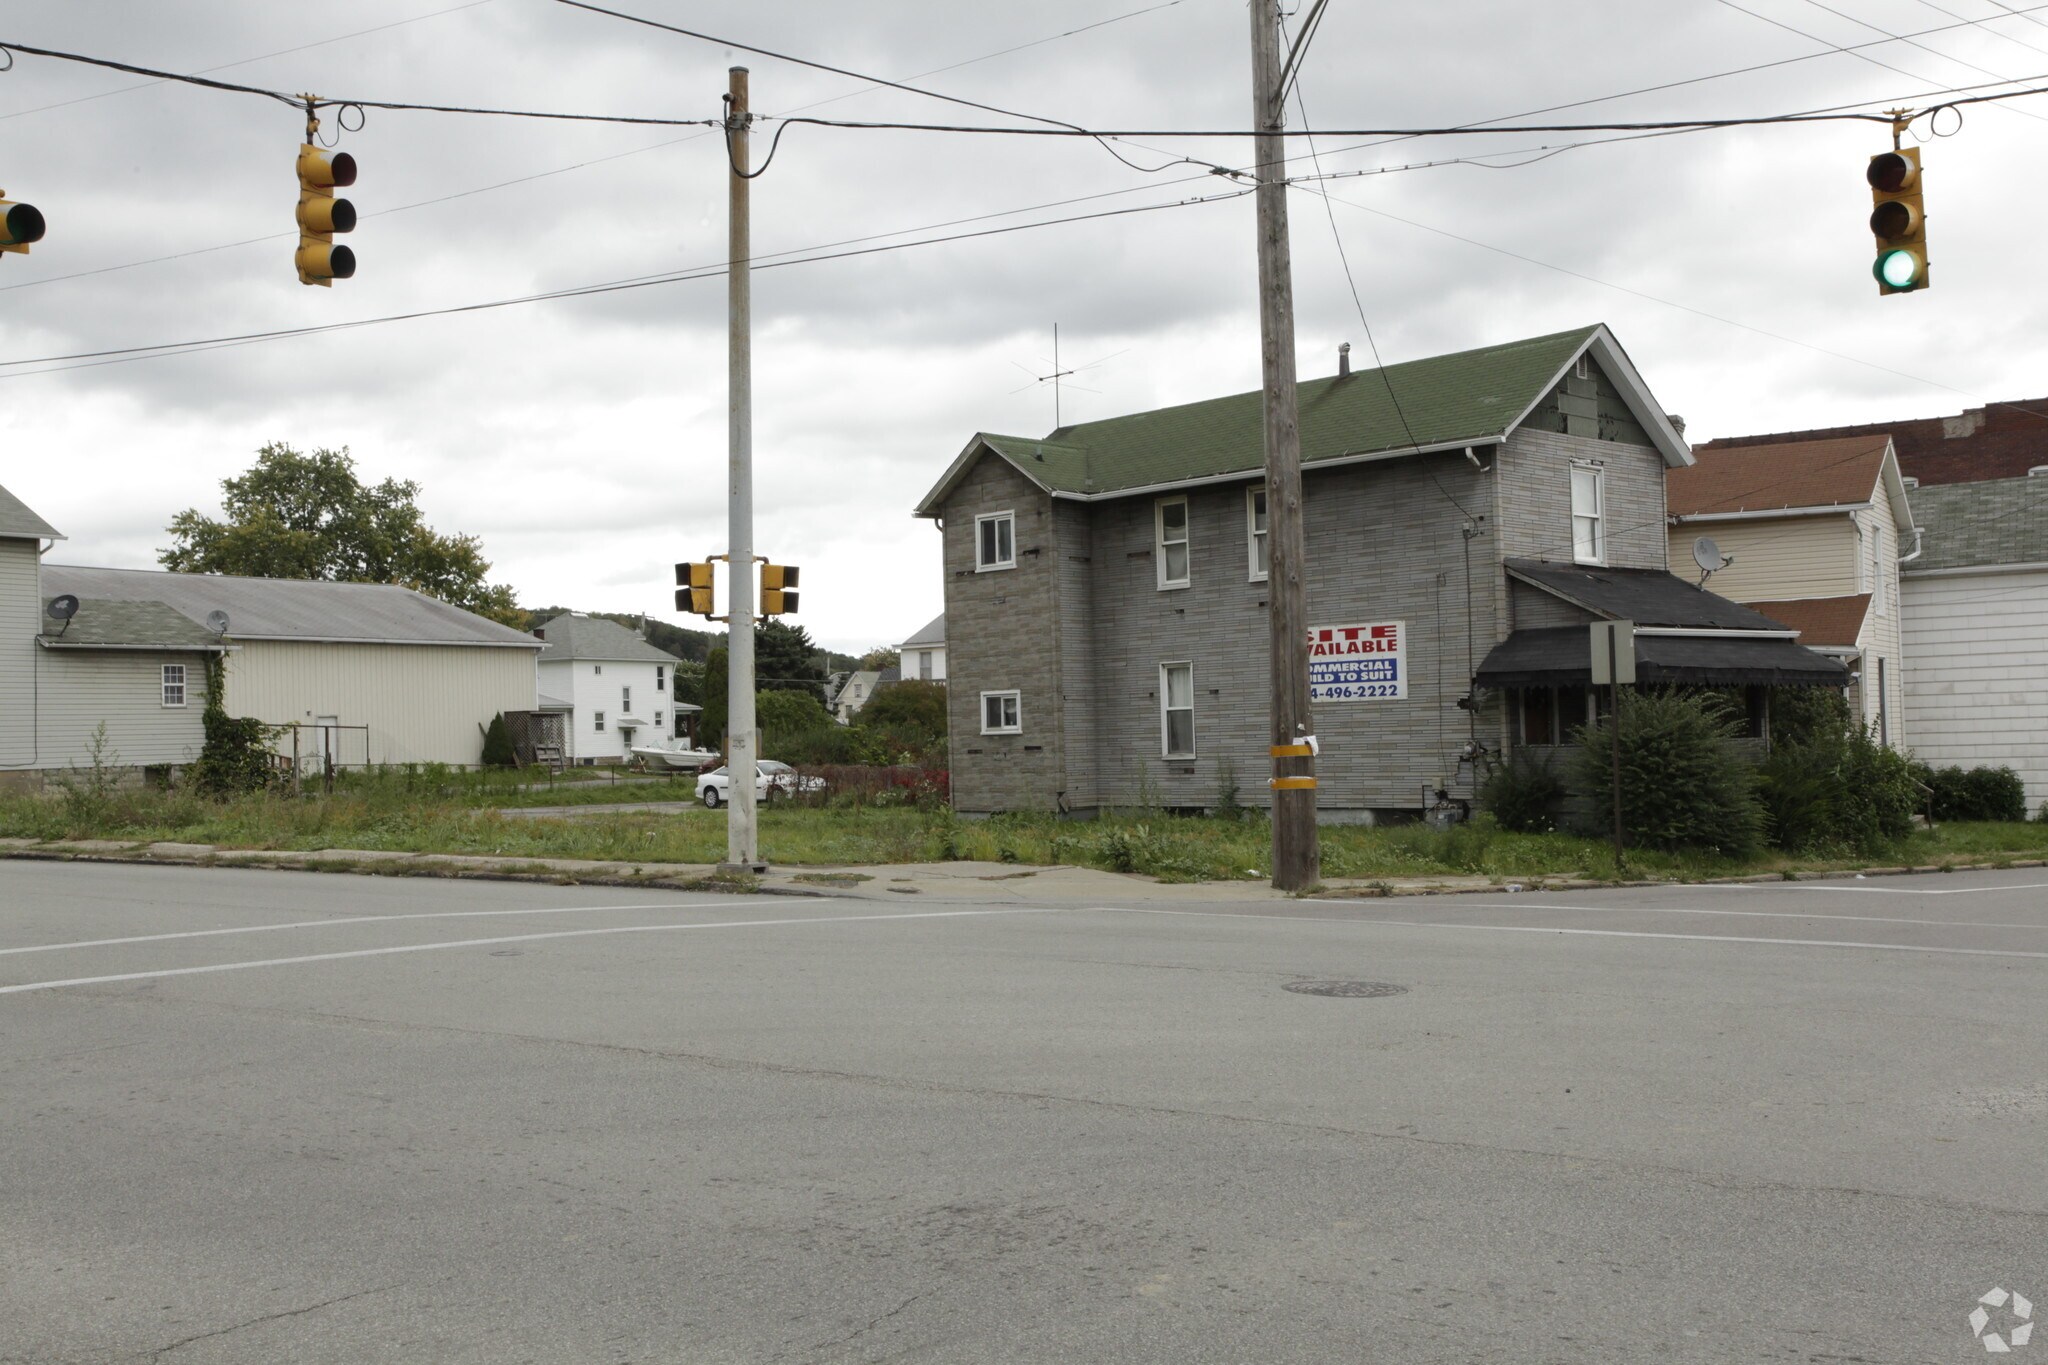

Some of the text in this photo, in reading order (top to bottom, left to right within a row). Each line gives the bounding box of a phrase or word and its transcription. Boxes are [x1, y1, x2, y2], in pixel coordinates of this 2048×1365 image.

[1308, 625, 1396, 642] ITE
[1310, 661, 1391, 673] MMERCIAL
[1310, 671, 1393, 682] ILD TO SUIT
[1311, 684, 1397, 699] 4-496-2222
